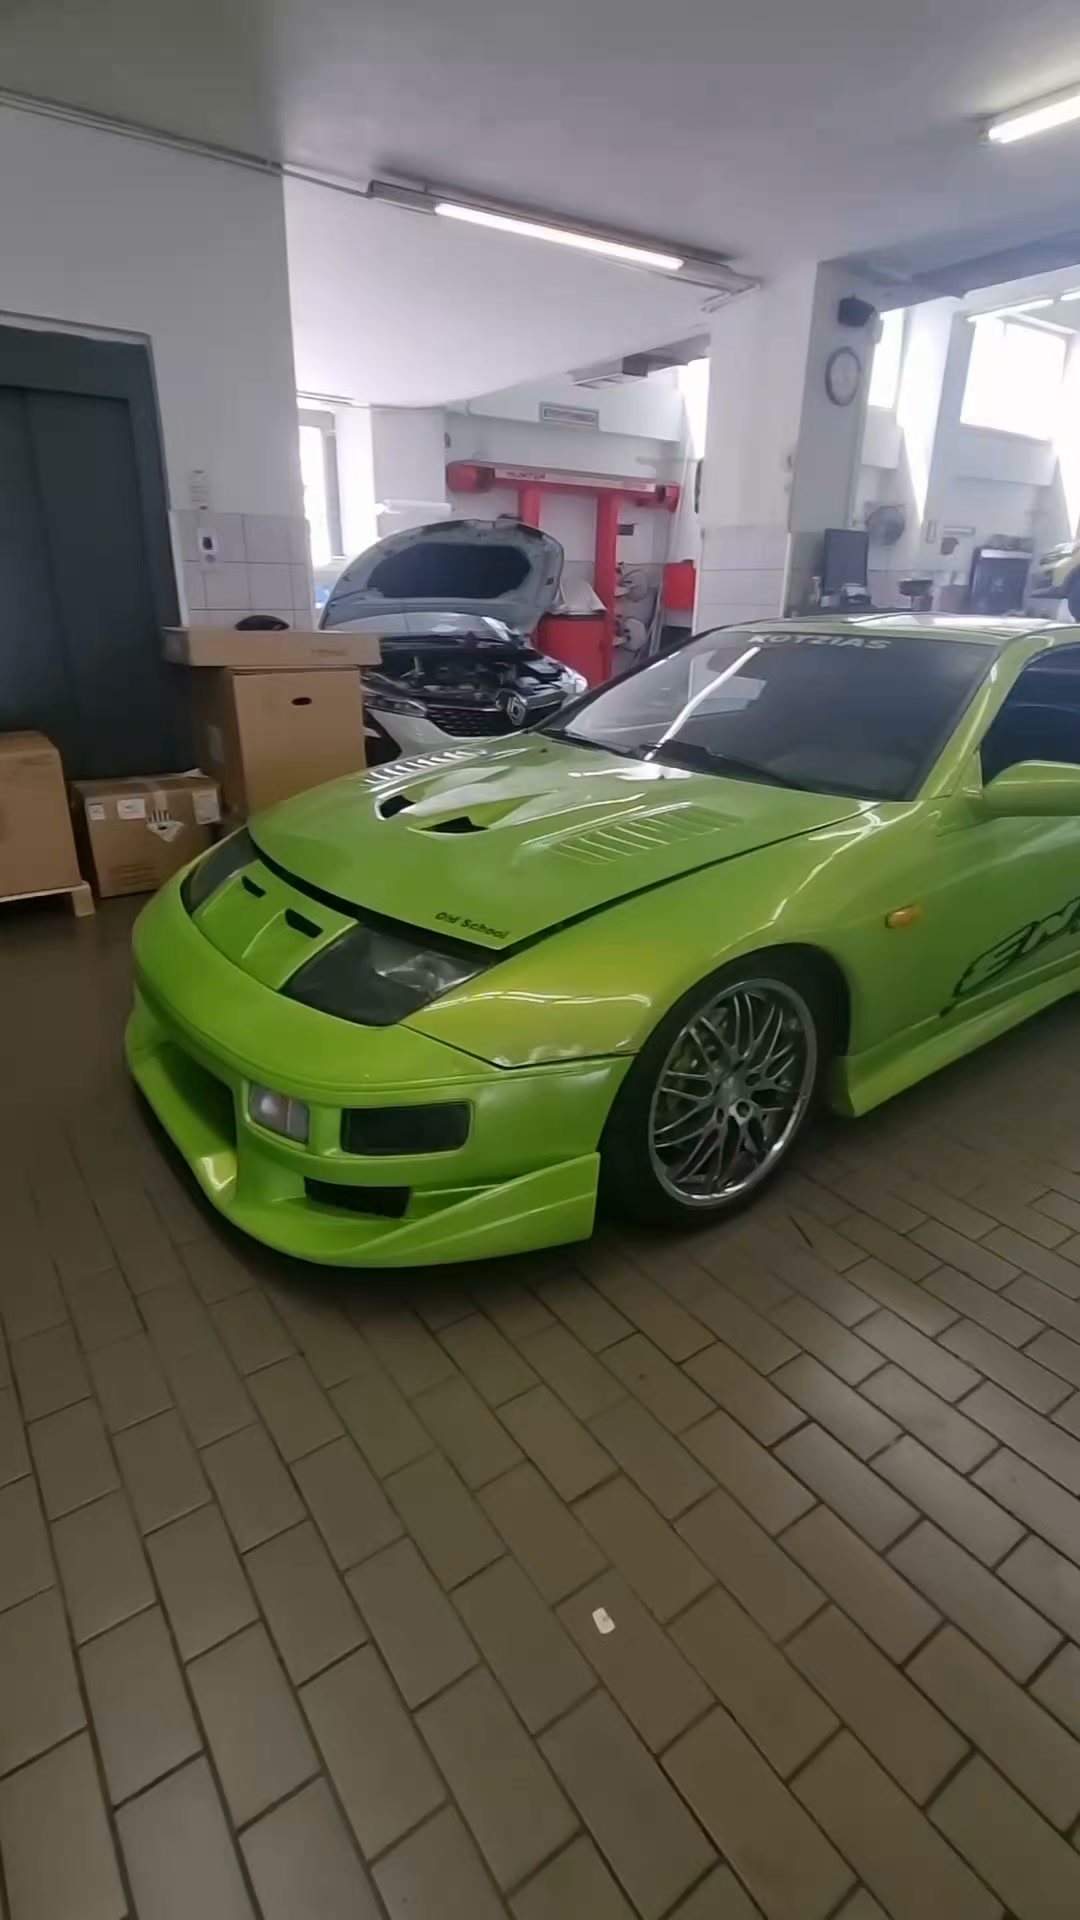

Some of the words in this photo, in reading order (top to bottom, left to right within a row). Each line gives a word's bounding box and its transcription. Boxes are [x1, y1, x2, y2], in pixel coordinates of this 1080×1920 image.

[747, 633, 891, 649] KOTZIAS
[435, 911, 461, 924] Old
[461, 919, 511, 940] School
